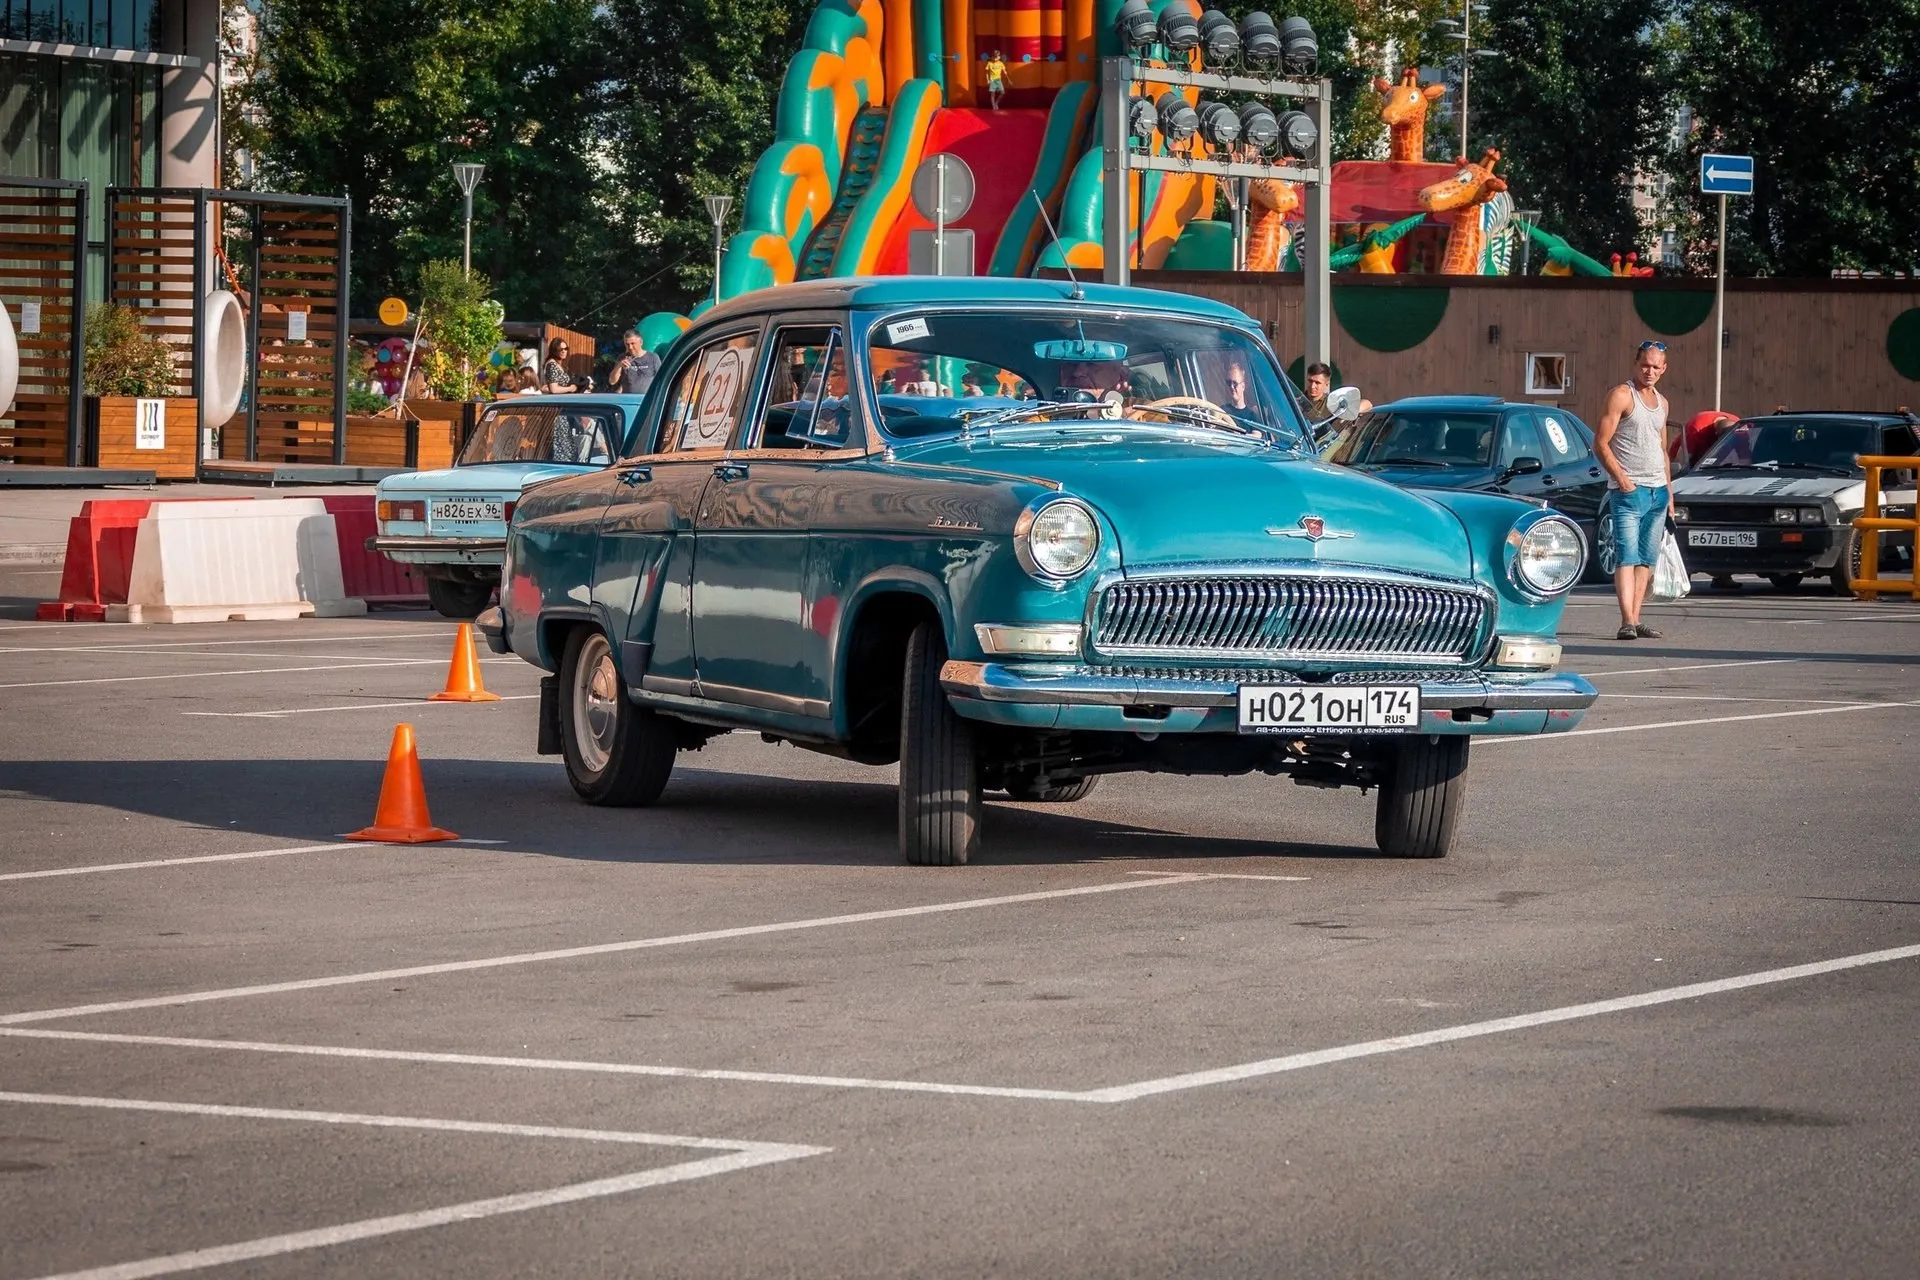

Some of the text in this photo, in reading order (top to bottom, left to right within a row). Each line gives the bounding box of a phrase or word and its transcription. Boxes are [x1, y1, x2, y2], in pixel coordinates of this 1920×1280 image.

[897, 323, 915, 334] 1965
[704, 372, 732, 416] 21
[485, 504, 498, 515] 96
[1737, 533, 1754, 543] 196
[1249, 690, 1412, 723] Н021ОН 174
[1384, 714, 1406, 724] RUS
[1256, 726, 1315, 734] AB-Automobile
[1316, 726, 1353, 735] Ettlingen
